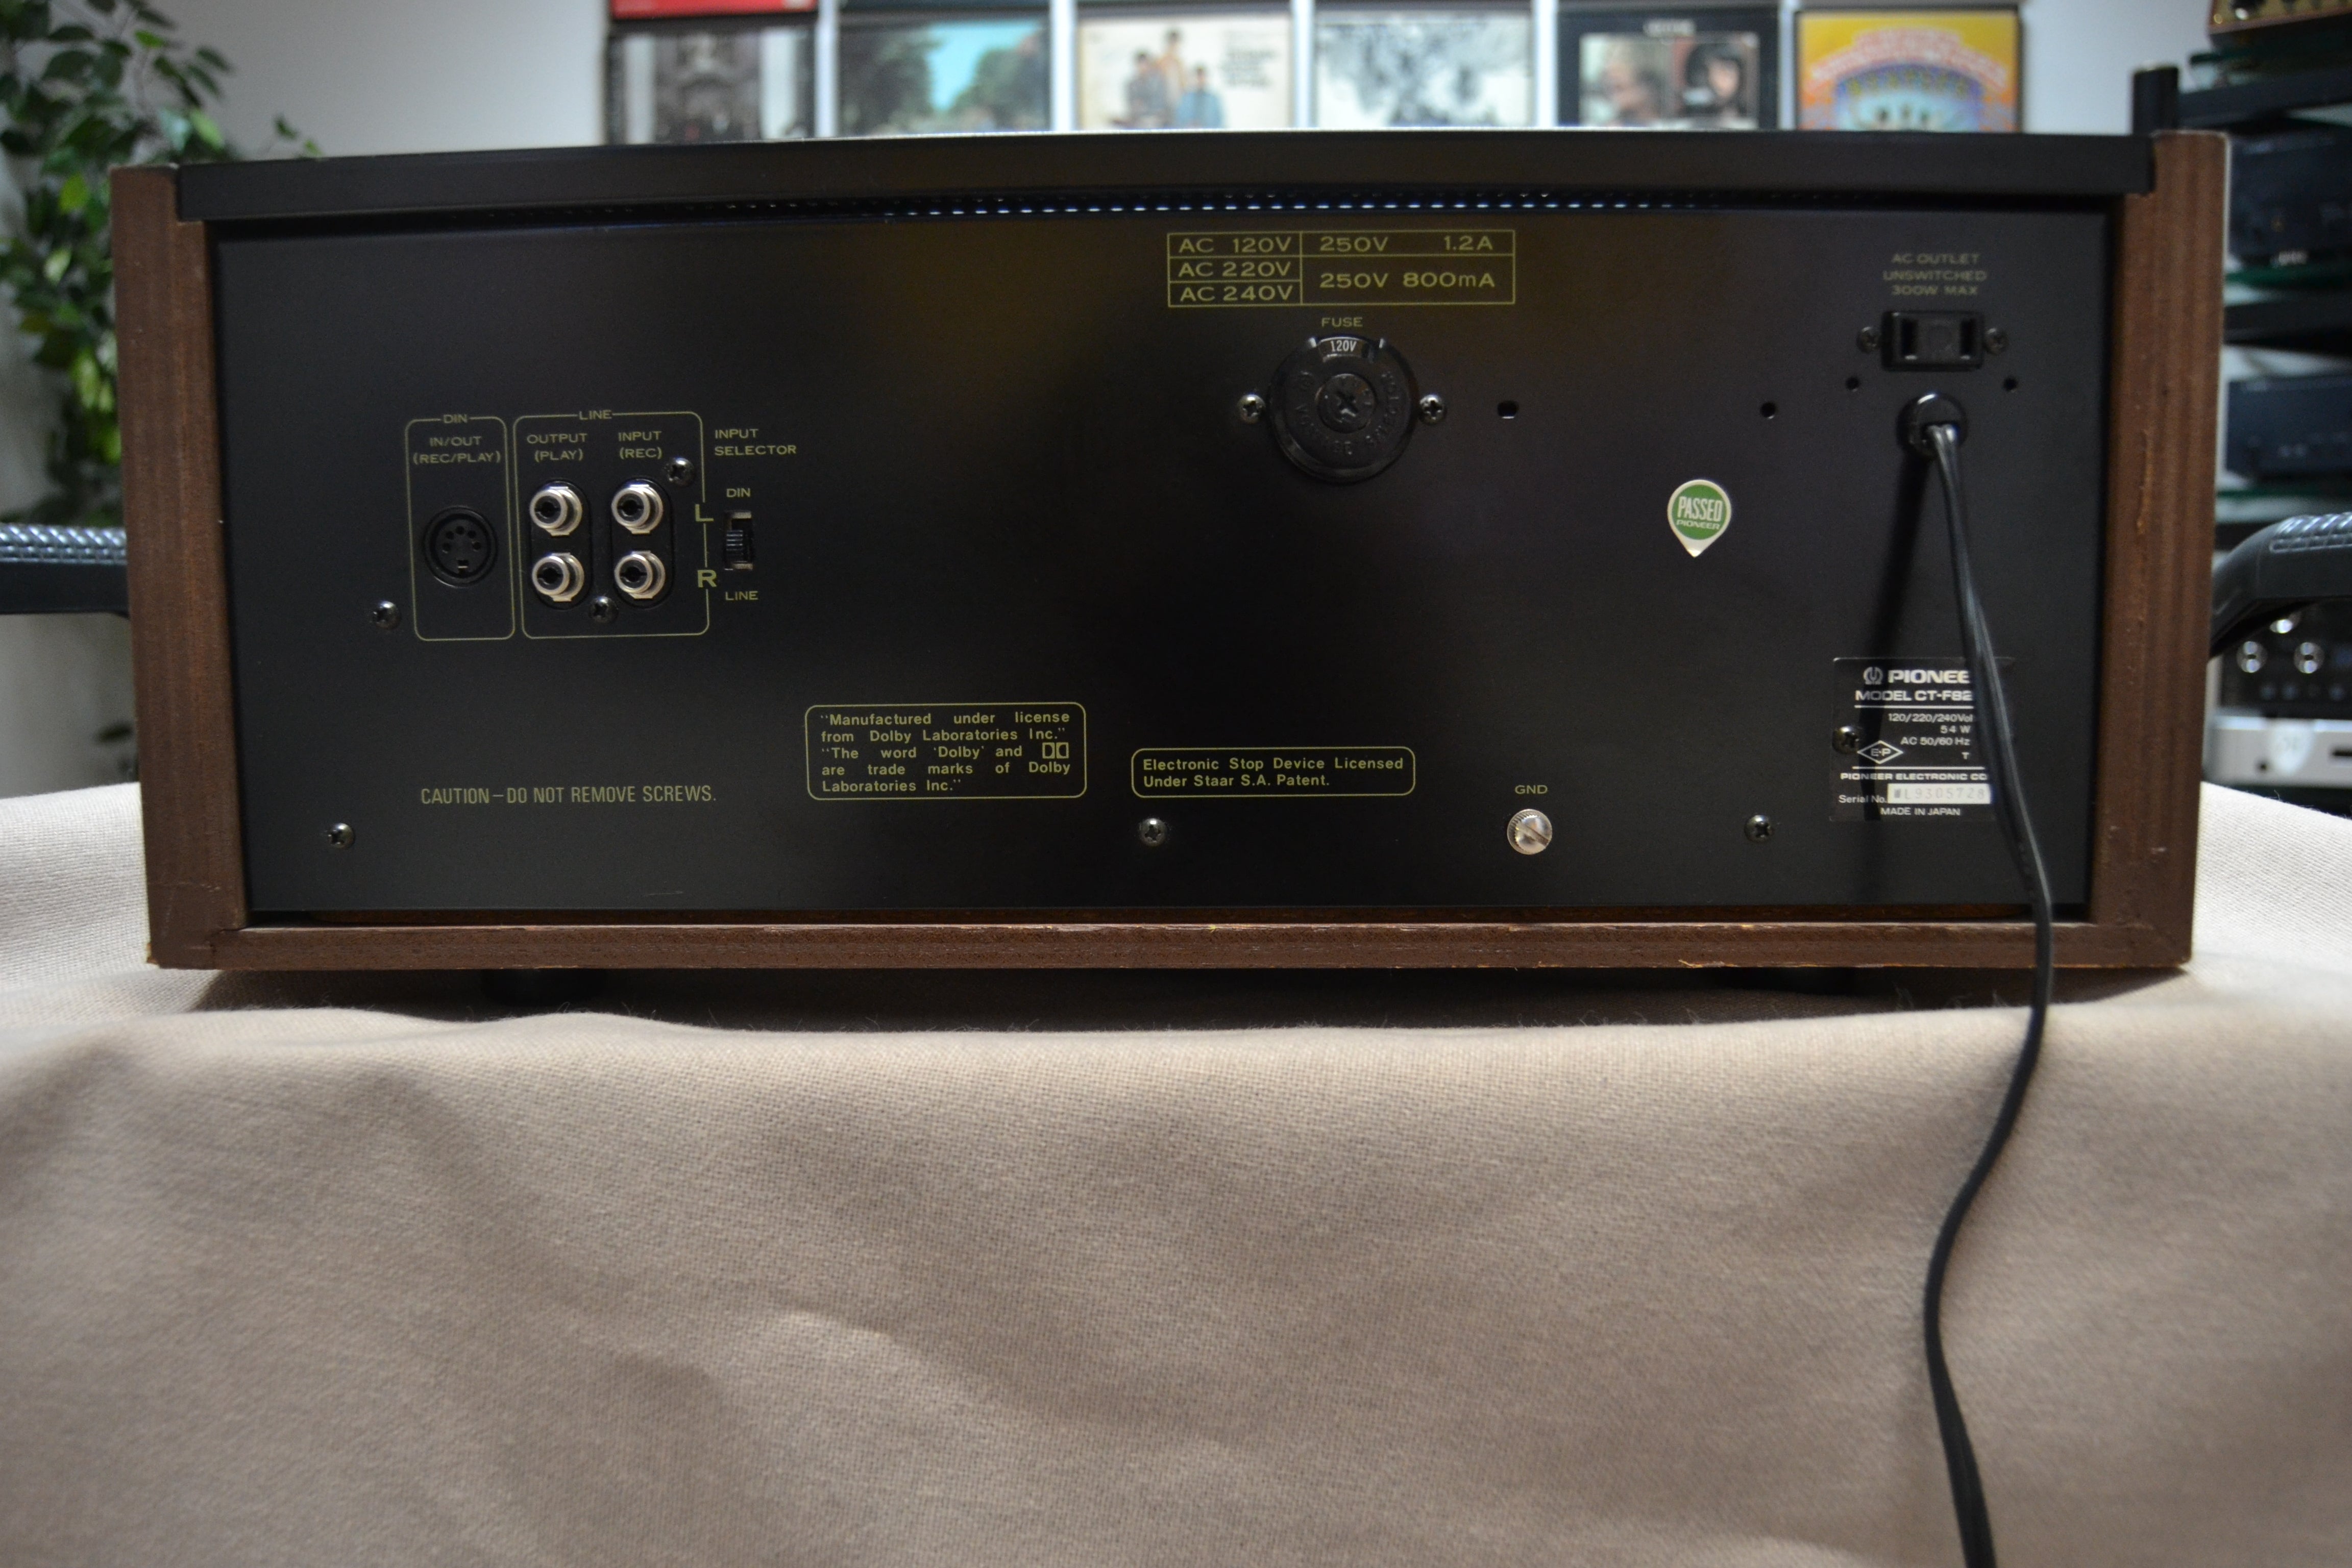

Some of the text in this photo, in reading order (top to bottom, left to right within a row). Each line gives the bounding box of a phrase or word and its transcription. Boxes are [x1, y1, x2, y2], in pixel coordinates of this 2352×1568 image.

[1179, 236, 1292, 253] AC 120V
[1319, 235, 1493, 252] 250V 1.2A
[1891, 253, 1979, 264] AC OUTLET
[1178, 261, 1292, 278] AC 220V
[1319, 272, 1495, 288] 250V 800mA
[1883, 271, 1987, 281] UNSWITCHED
[1180, 285, 1293, 302] AC 240V
[1891, 285, 1977, 296] 300W MAX
[1321, 317, 1363, 328] FUSE
[1330, 340, 1357, 352] 120V
[443, 414, 468, 424] DIN
[578, 410, 612, 420] LINE
[526, 433, 588, 444] OUTPUT
[618, 431, 662, 442] INPUT
[714, 429, 759, 439] INPUT
[429, 436, 482, 447] IN/OUT
[533, 448, 584, 462] (PLAY)
[619, 447, 663, 460] (REC)
[714, 444, 797, 456] SELECTOR
[412, 450, 501, 464] (REC/PLAY)
[726, 487, 751, 498] DIN
[694, 504, 714, 522] L
[1677, 496, 1723, 522] PASSED
[1676, 519, 1720, 530] PIONEER
[697, 569, 717, 588] R
[725, 591, 758, 601] LINE
[1889, 669, 1970, 684] PIONEE
[1855, 690, 1973, 701] MODEL CT-F82
[953, 713, 995, 725] under
[1015, 712, 1070, 723] license
[1889, 713, 1973, 723] 120/220/240Vol
[821, 731, 854, 742] from
[870, 730, 912, 744] Dolby
[922, 729, 1018, 742] Laboratories
[1900, 737, 1970, 746] AC 50/60 Hz
[881, 747, 916, 758] word
[995, 745, 1022, 757] and
[821, 762, 1070, 776] are trade marks of Dolby
[1143, 757, 1403, 771] Electronic Stop Device Licensed
[1143, 774, 1330, 788] Under Staar S.A. Patent.
[1895, 773, 1968, 781] ELECTRONIC
[822, 780, 916, 793] Laboratories
[1515, 785, 1548, 794] GND
[533, 787, 565, 803] NOT
[571, 786, 636, 803] REMOVE
[643, 785, 716, 802] SCREWS.
[1839, 795, 1868, 803] Serial
[1880, 807, 1911, 816] MADE
[1927, 807, 1961, 816] JAPAN
